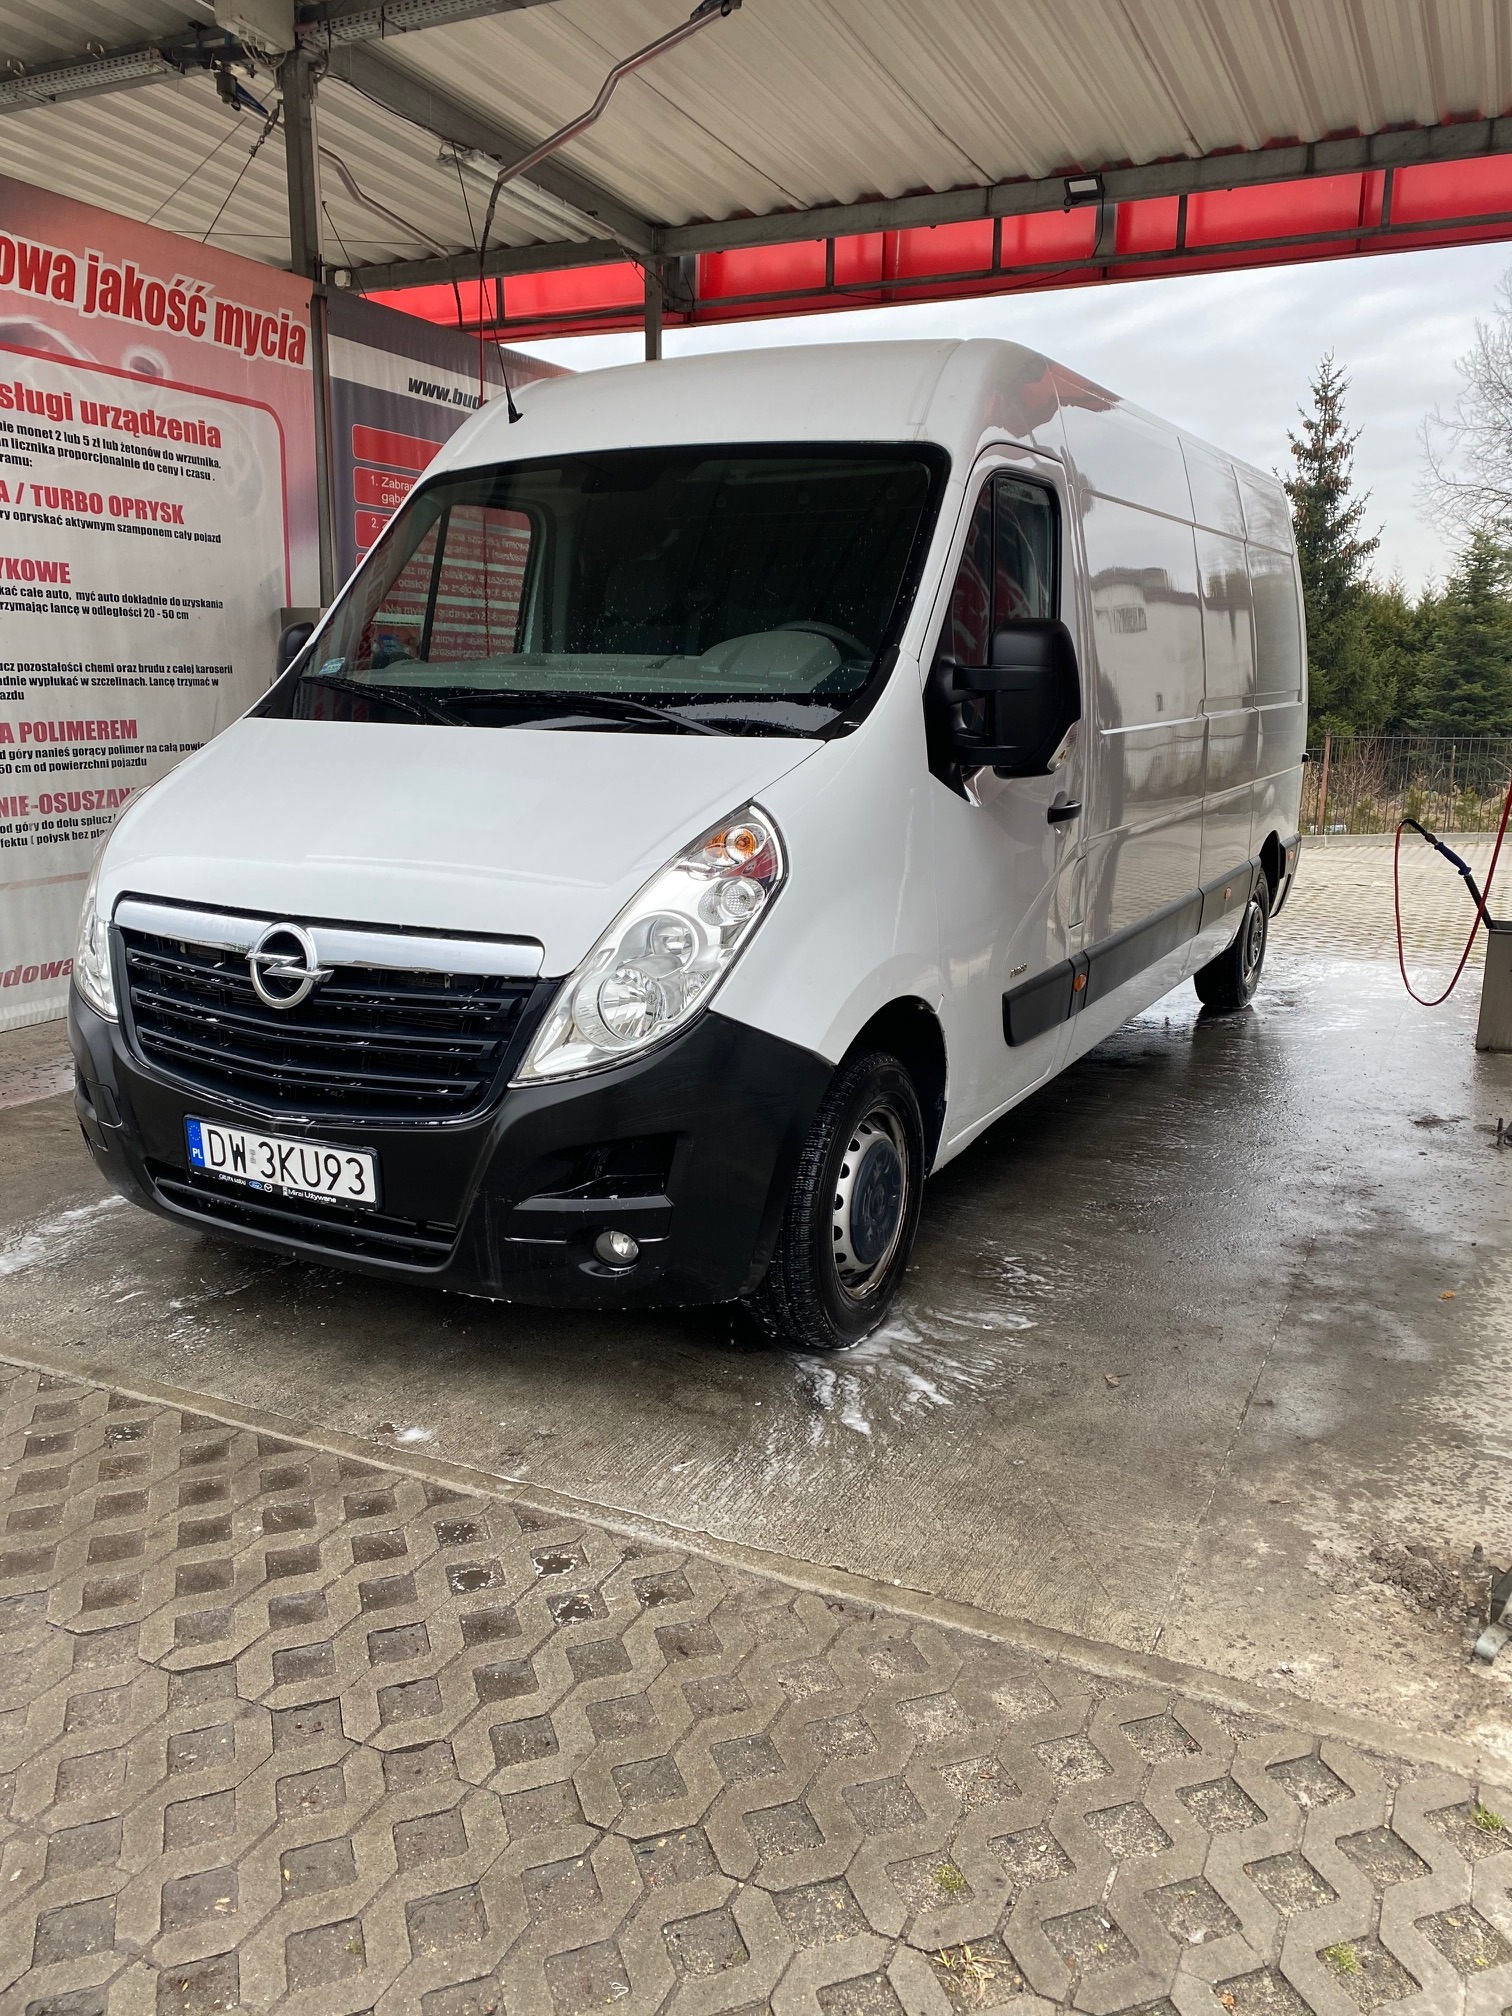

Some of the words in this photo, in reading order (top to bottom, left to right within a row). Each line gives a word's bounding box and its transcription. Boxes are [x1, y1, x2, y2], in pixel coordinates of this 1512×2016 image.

[83, 254, 207, 338] jakość
[214, 302, 306, 365] mycia
[408, 377, 489, 410] www.bud
[0, 381, 73, 422] sługi
[80, 400, 221, 448] urządzenia
[11, 438, 55, 456] licznika
[57, 447, 140, 469] proporcjonalnie
[143, 460, 155, 471] do
[157, 462, 178, 476] ceny
[180, 466, 184, 477] i
[17, 425, 53, 440] monet
[55, 430, 62, 441] 2
[64, 432, 80, 445] lub
[83, 435, 90, 446] 5
[102, 439, 119, 451] lub
[121, 442, 160, 459] żetonów
[163, 450, 174, 461] do
[176, 453, 221, 469] wrzutnika.
[15, 482, 25, 504] /
[30, 483, 103, 515] TURBO
[108, 495, 185, 525] OPRYSK
[13, 511, 63, 526] opryskać
[65, 517, 115, 532] aktywnym
[117, 524, 172, 538] szamponem
[194, 532, 221, 543] pojazd
[46, 589, 72, 601] auto,
[76, 591, 96, 602] myć
[98, 593, 120, 603] auto
[122, 593, 168, 606] dokładnie
[170, 597, 181, 607] do
[182, 598, 223, 609] uzyskania
[50, 603, 80, 616] lancę
[82, 605, 90, 615] w
[92, 605, 142, 618] odległości
[143, 608, 155, 618] 20
[162, 609, 174, 619] 50
[176, 611, 189, 620] cm
[17, 662, 82, 673] pozostałości
[85, 662, 114, 673] chemi
[116, 664, 137, 673] oraz
[138, 663, 165, 674] brudu
[166, 665, 171, 674] z
[195, 664, 233, 675] karoserii
[28, 675, 78, 688] wypłukać
[80, 677, 89, 686] w
[91, 676, 148, 687] szczelinach.
[149, 677, 175, 688] Lancę
[177, 677, 210, 687] trzymać
[211, 678, 219, 687] w
[0, 722, 15, 744] A
[19, 719, 138, 743] POLIMEREM
[9, 748, 33, 761] góry
[35, 746, 71, 759] nanieś
[72, 745, 107, 758] gorący
[108, 744, 144, 756] polimer
[146, 744, 158, 754] na
[15, 764, 31, 774] cm
[34, 762, 47, 772] od
[49, 759, 109, 773] powierzchni
[111, 757, 147, 769] pojazdu
[0, 787, 136, 818] NIE-OSUSZAN
[0, 823, 13, 834] od
[15, 822, 39, 834] góry
[41, 820, 54, 830] do
[36, 833, 70, 846] połysk
[71, 830, 89, 841] bez
[0, 958, 74, 988] dowa
[192, 1147, 204, 1160] PL
[207, 1128, 247, 1174] DW
[258, 1141, 366, 1196] 3KU93
